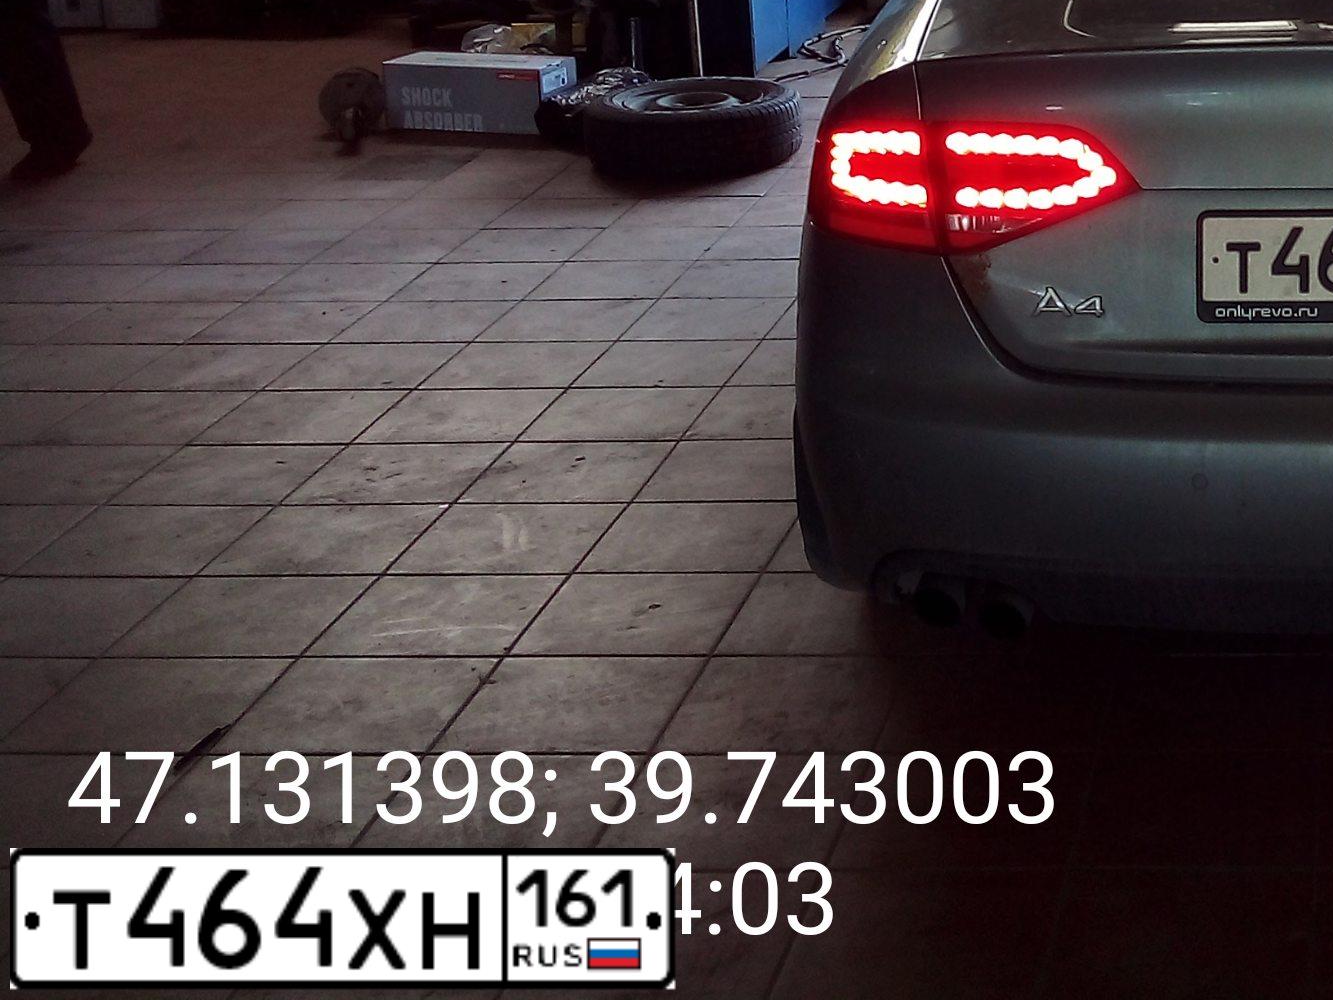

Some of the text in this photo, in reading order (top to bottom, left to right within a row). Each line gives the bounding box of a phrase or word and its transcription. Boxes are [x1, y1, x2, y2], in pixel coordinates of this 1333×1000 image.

[400, 86, 454, 108] SHOCK
[1031, 286, 1105, 318] A4
[1214, 304, 1319, 321] onlyrevo.ru
